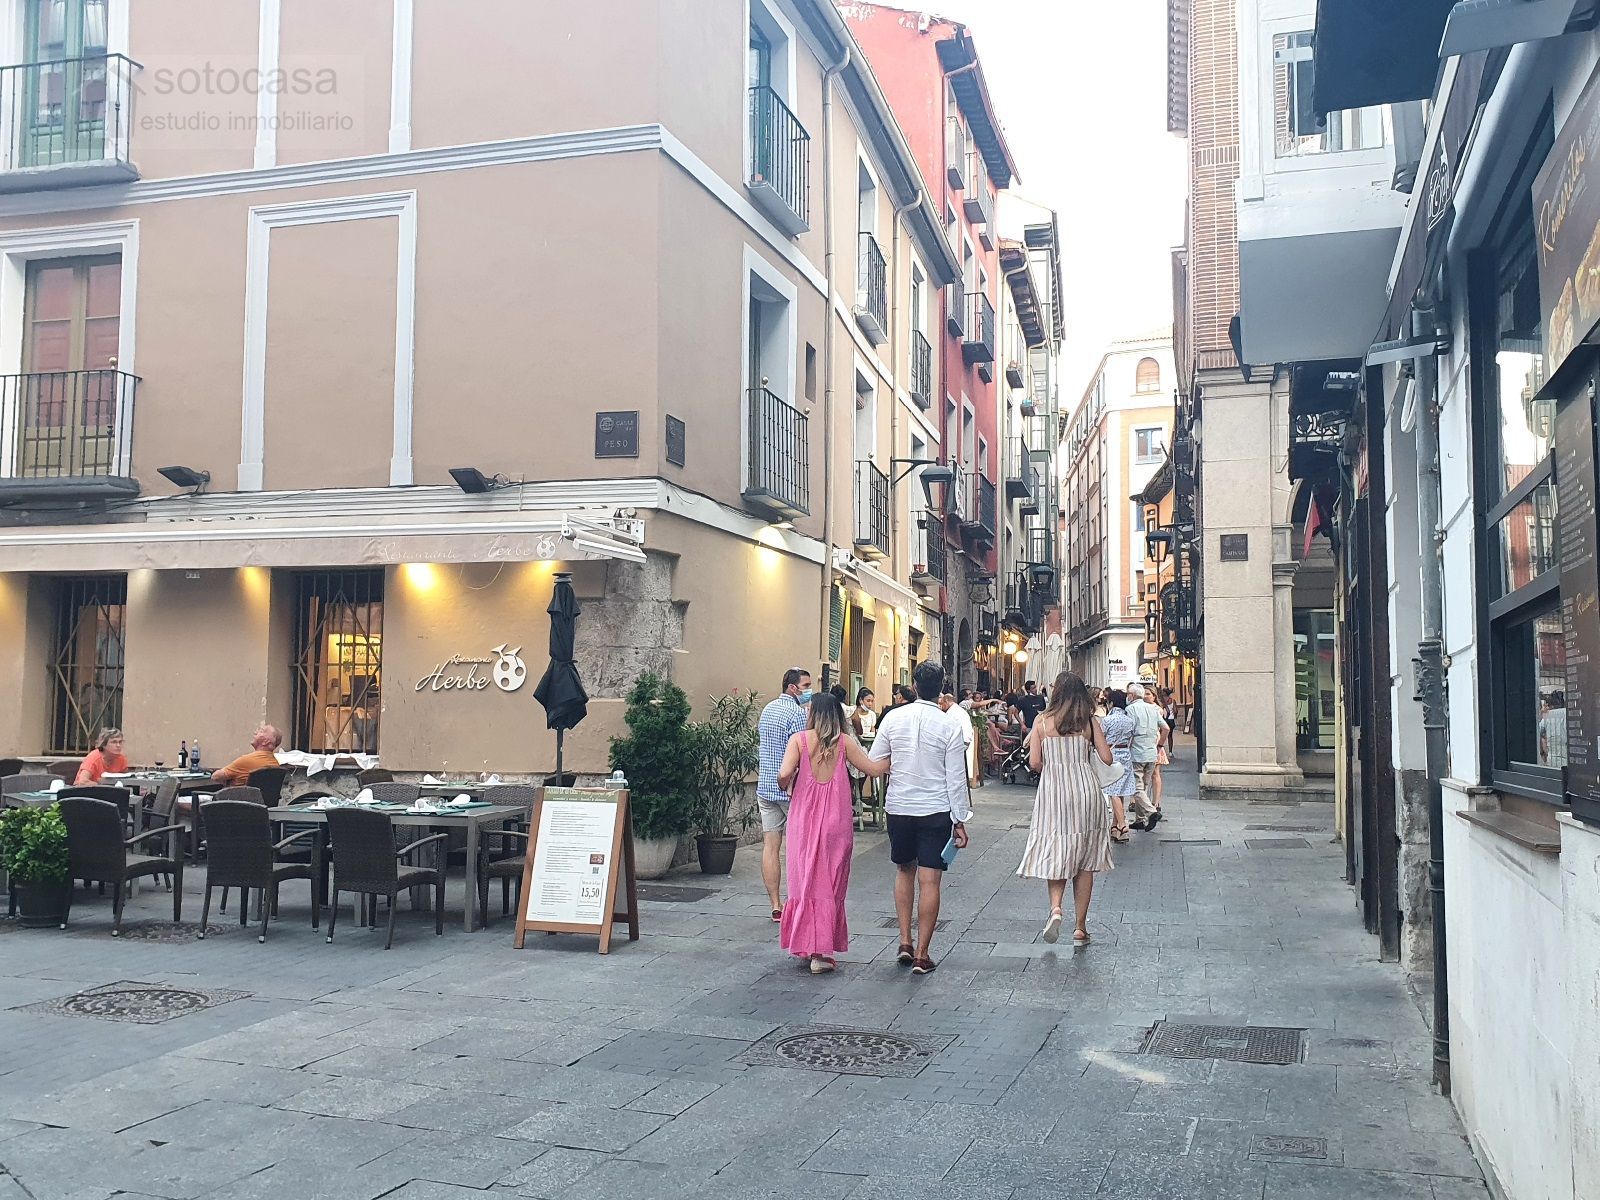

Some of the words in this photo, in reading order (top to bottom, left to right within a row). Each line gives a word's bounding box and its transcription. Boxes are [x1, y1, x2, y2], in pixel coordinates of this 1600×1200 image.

[1538, 135, 1586, 267] Romeritos
[604, 439, 629, 448] PESO
[415, 659, 491, 691] Herbe
[581, 887, 600, 900] 15,50
